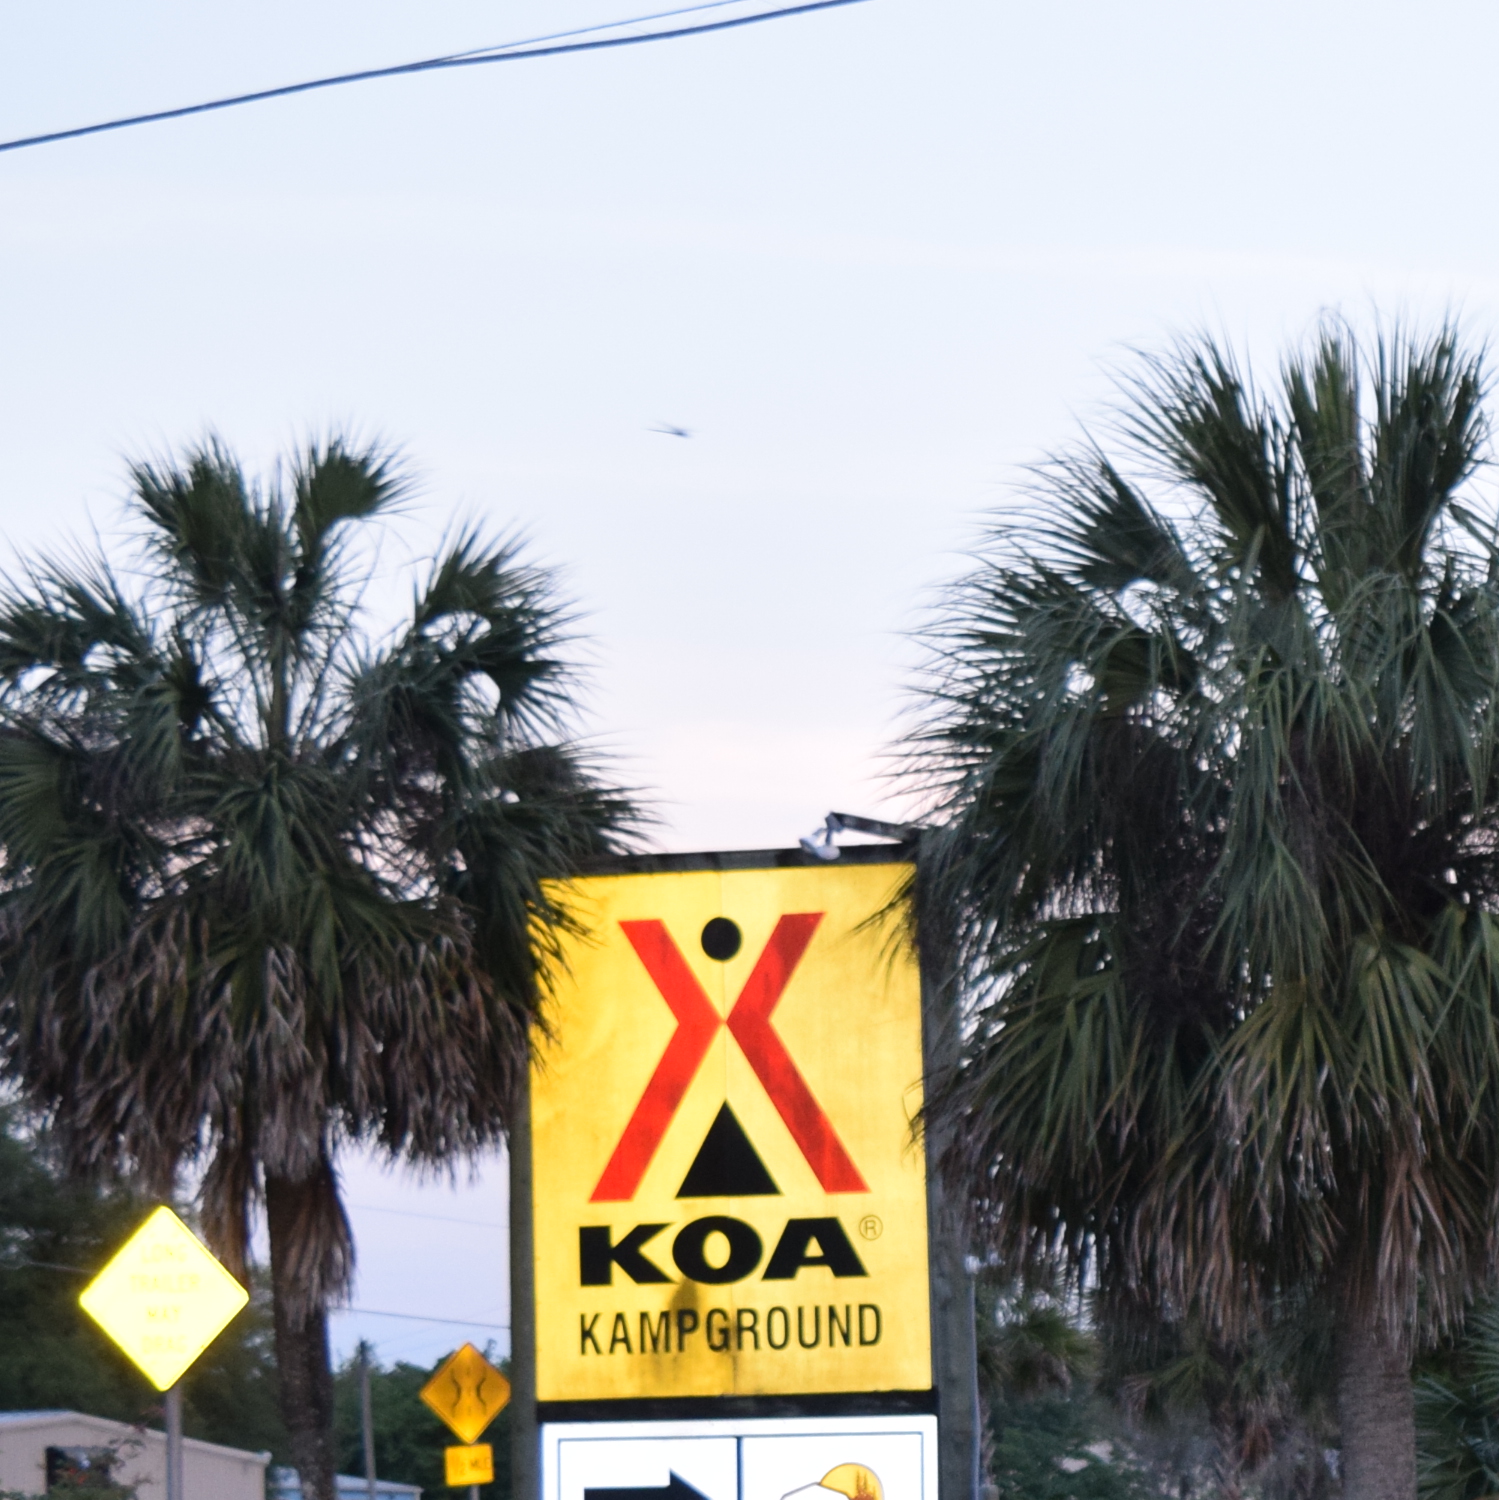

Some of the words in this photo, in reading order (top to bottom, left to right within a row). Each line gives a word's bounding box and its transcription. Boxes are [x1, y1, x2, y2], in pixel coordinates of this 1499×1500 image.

[141, 1243, 188, 1265] LONG
[579, 1215, 870, 1286] KOA
[129, 1272, 202, 1294] TRAILER
[145, 1304, 182, 1324] MAY
[580, 1304, 881, 1355] KAMPGROUND
